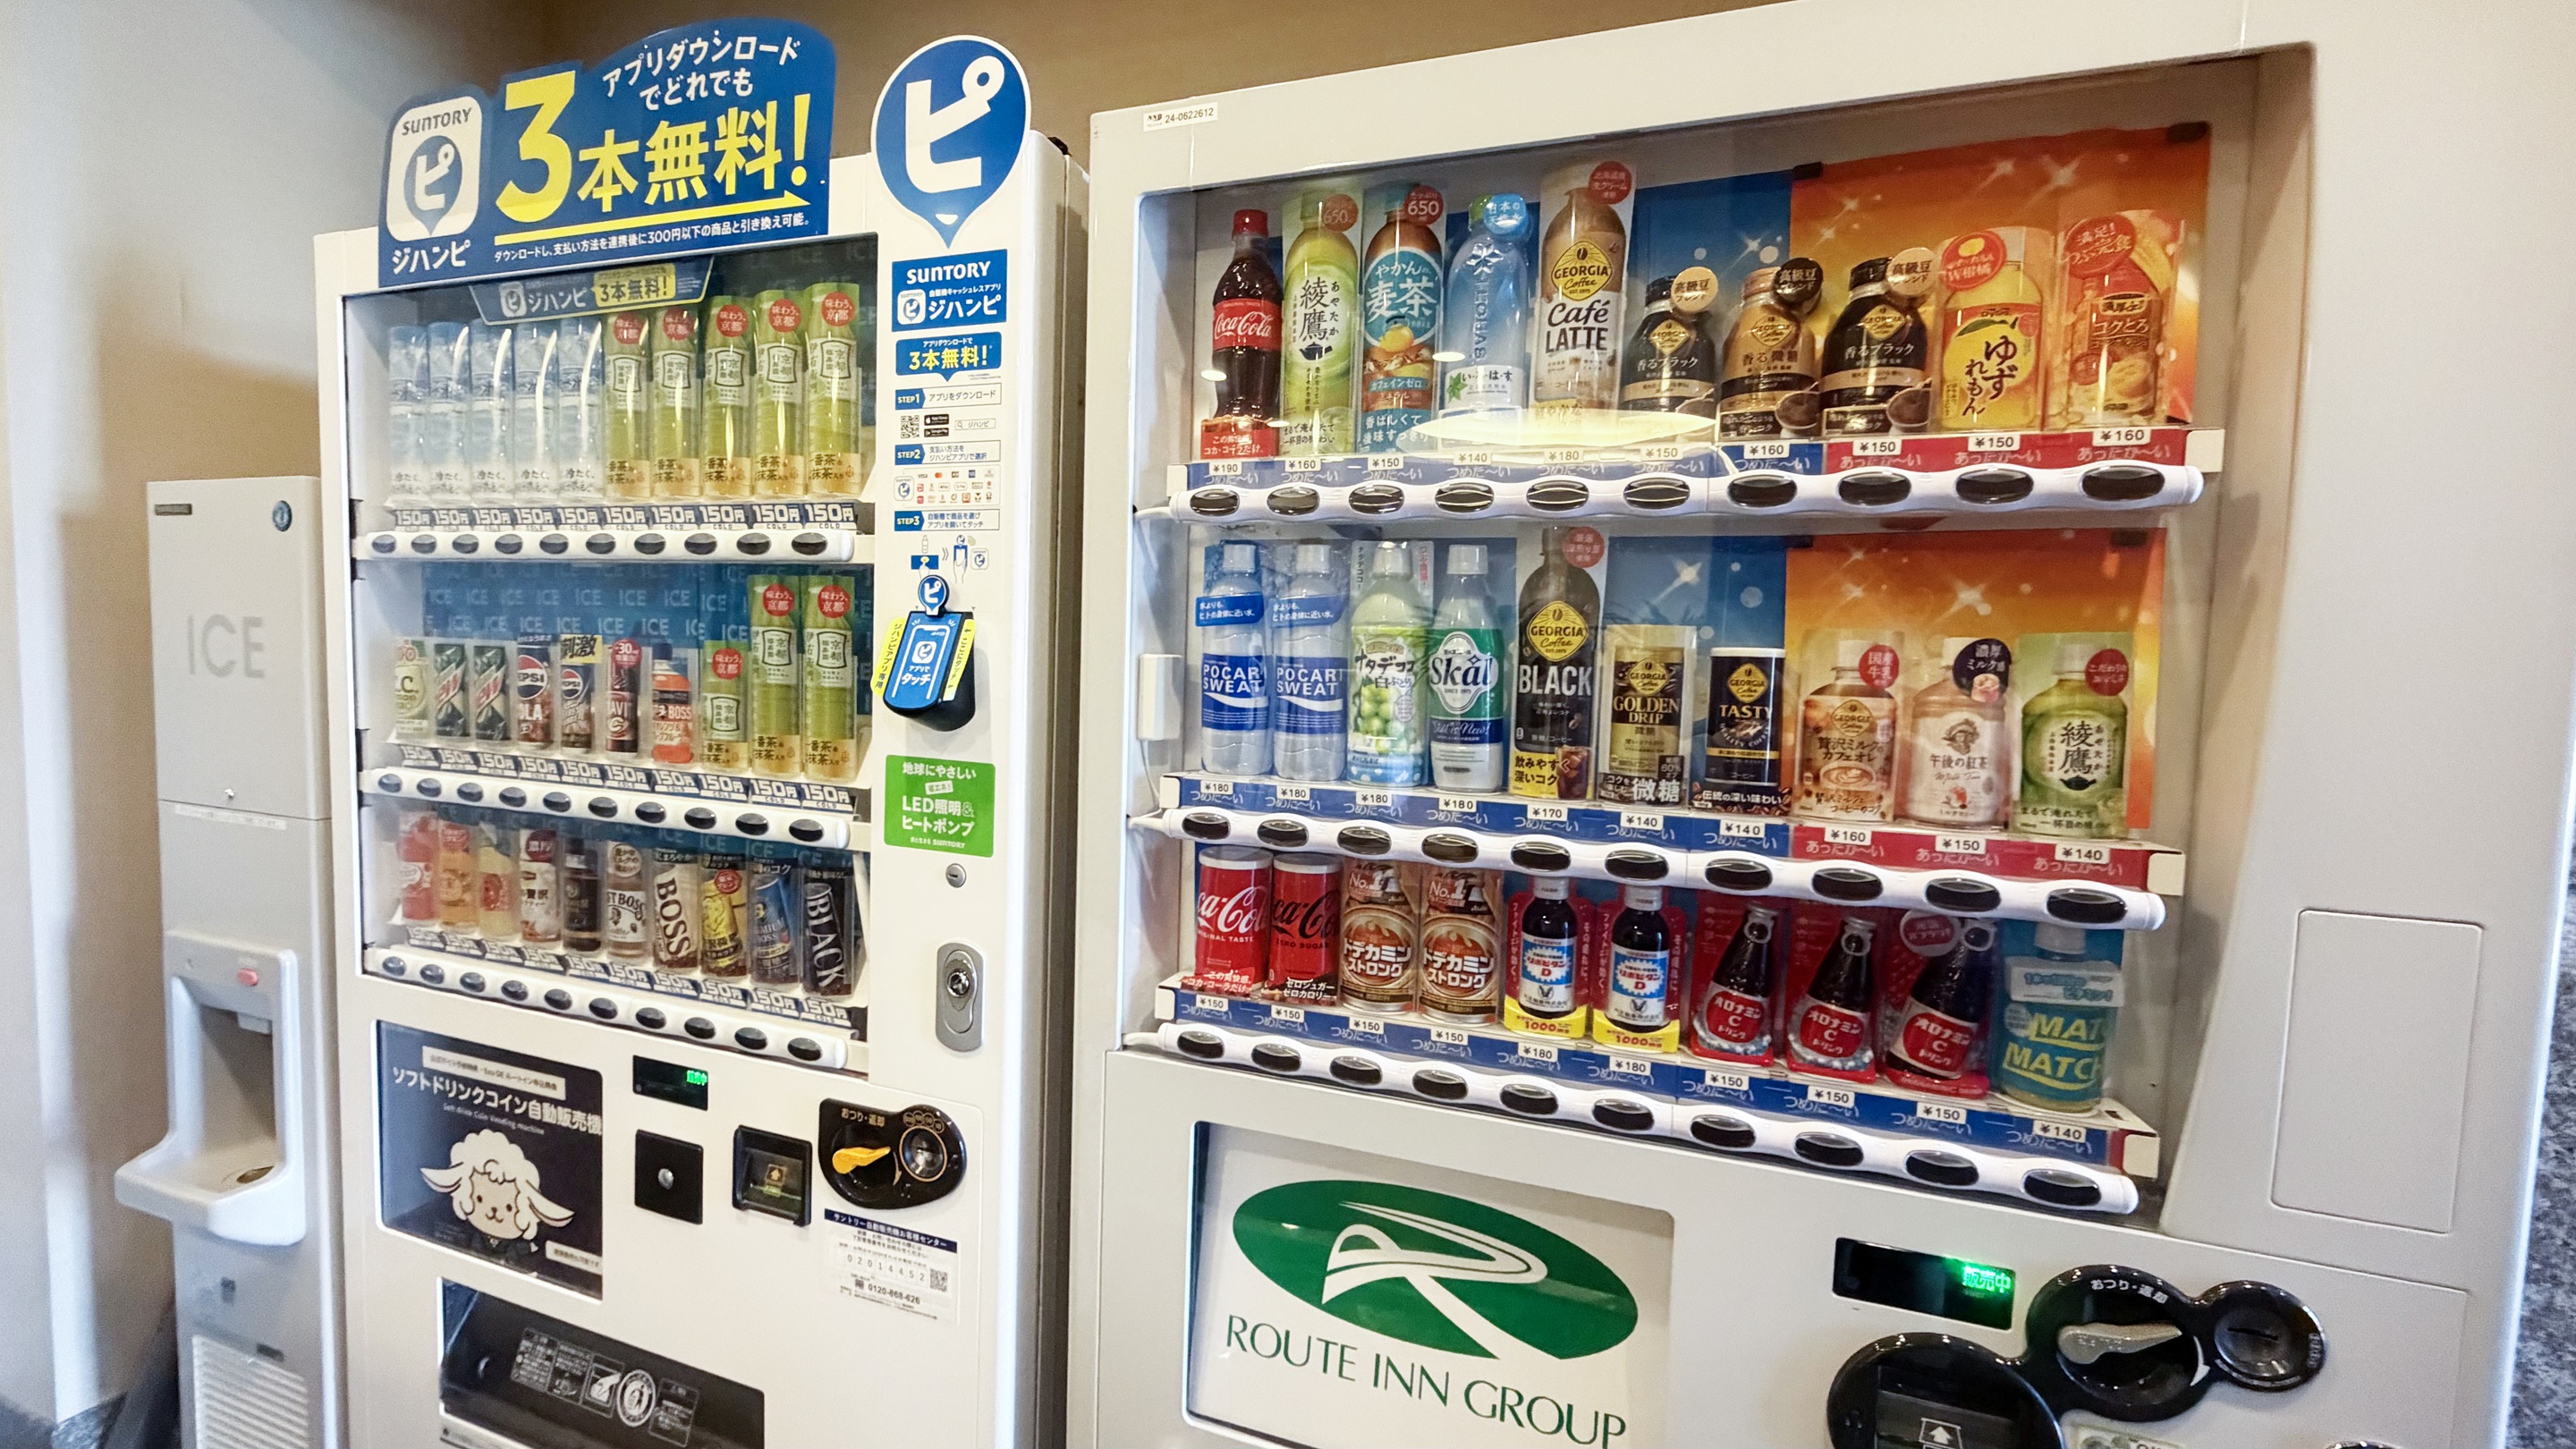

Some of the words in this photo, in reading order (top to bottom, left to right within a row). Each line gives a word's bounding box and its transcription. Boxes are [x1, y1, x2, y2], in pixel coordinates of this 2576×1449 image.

[603, 30, 801, 97] アプリダウンロード
[640, 68, 753, 110] でどれでも
[402, 107, 473, 136] SUNTORY
[905, 55, 1005, 193] ピ
[1408, 199, 1439, 216] 650
[392, 240, 470, 275] ジハンピ
[906, 261, 991, 284] SUNTORY
[1554, 266, 1608, 279] GEORGIA
[1563, 278, 1597, 289] Coffee
[528, 287, 588, 313] ジハンピ
[928, 294, 1001, 320] ジハンピ
[1366, 278, 1437, 321] 麦茶
[1301, 277, 1331, 341] 綾鷹
[1329, 280, 1341, 337] あやたか
[1547, 301, 1610, 327] Café
[1214, 311, 1272, 340] Coca-Cola
[1546, 327, 1608, 354] LATTE
[1984, 335, 2019, 400] ゆず
[1369, 379, 1422, 392] カフェインゼロ
[1962, 358, 1987, 416] れもん
[929, 390, 996, 402] アプリをダウンロード
[1975, 437, 2013, 447] ¥150
[2102, 431, 2144, 441] ¥160
[1646, 449, 1678, 458] ¥150
[1750, 445, 1784, 454] ¥160
[1860, 442, 1895, 452] ¥150
[1373, 459, 1399, 468] ¥150
[1459, 453, 1487, 462] ¥140
[1549, 452, 1579, 461] ¥180
[1214, 464, 1238, 473] ¥190
[1289, 460, 1316, 470] ¥160
[1530, 626, 1585, 638] GEORGIA
[188, 614, 266, 678] ICE
[901, 673, 931, 685] タッチ
[1204, 678, 1262, 693] SWEAT
[1519, 665, 1592, 696] BLACK
[1277, 682, 1338, 696] SWEAT
[1614, 697, 1680, 713] GOLDEN
[1719, 704, 1773, 719] TASTY
[1628, 713, 1664, 724] DRIP
[2060, 720, 2096, 775] 綾鷹
[902, 762, 977, 780] 地球にやさしい
[1514, 772, 1558, 784] 深いコク
[1205, 783, 1229, 793] ¥180
[1281, 788, 1307, 799] ¥180
[1632, 779, 1681, 802] 微糖
[1361, 793, 1388, 804] ¥180
[1444, 799, 1473, 809] ¥180
[1702, 790, 1782, 805] 伝統の深い味わい
[1532, 808, 1563, 818] ¥170
[902, 815, 975, 837] ヒートポンプ
[1626, 816, 1658, 827] ¥140
[1724, 825, 1761, 836] ¥140
[1831, 830, 1866, 843] ¥160
[1943, 839, 1979, 852] ¥150
[2062, 848, 2103, 860] ¥140
[657, 877, 691, 956] BOSS
[806, 893, 844, 987] BLACK
[1348, 957, 1402, 978] ストロング
[1527, 957, 1565, 968] リポビタン
[1428, 969, 1486, 988] ストロング
[1619, 970, 1661, 980] リポビタン
[1283, 989, 1333, 1000] ゼロカロリー
[1199, 997, 1224, 1008] ¥150
[1714, 997, 1762, 1018] オロナミン
[1275, 1008, 1301, 1020] ¥150
[1353, 1021, 1379, 1031] ¥150
[1809, 1011, 1860, 1034] オロナミン
[1436, 1031, 1463, 1043] ¥150
[1914, 1016, 1969, 1045] オロナミン
[1710, 1075, 1742, 1087] ¥150
[393, 1067, 602, 1136] ソフトドリンクコイン自動販売機
[2040, 1124, 2081, 1140] ¥140
[1962, 1266, 2011, 1293] 販売中
[1226, 1314, 1358, 1381] ROUTE
[1373, 1352, 1449, 1407] INN
[1464, 1378, 1627, 1449] GROUP
